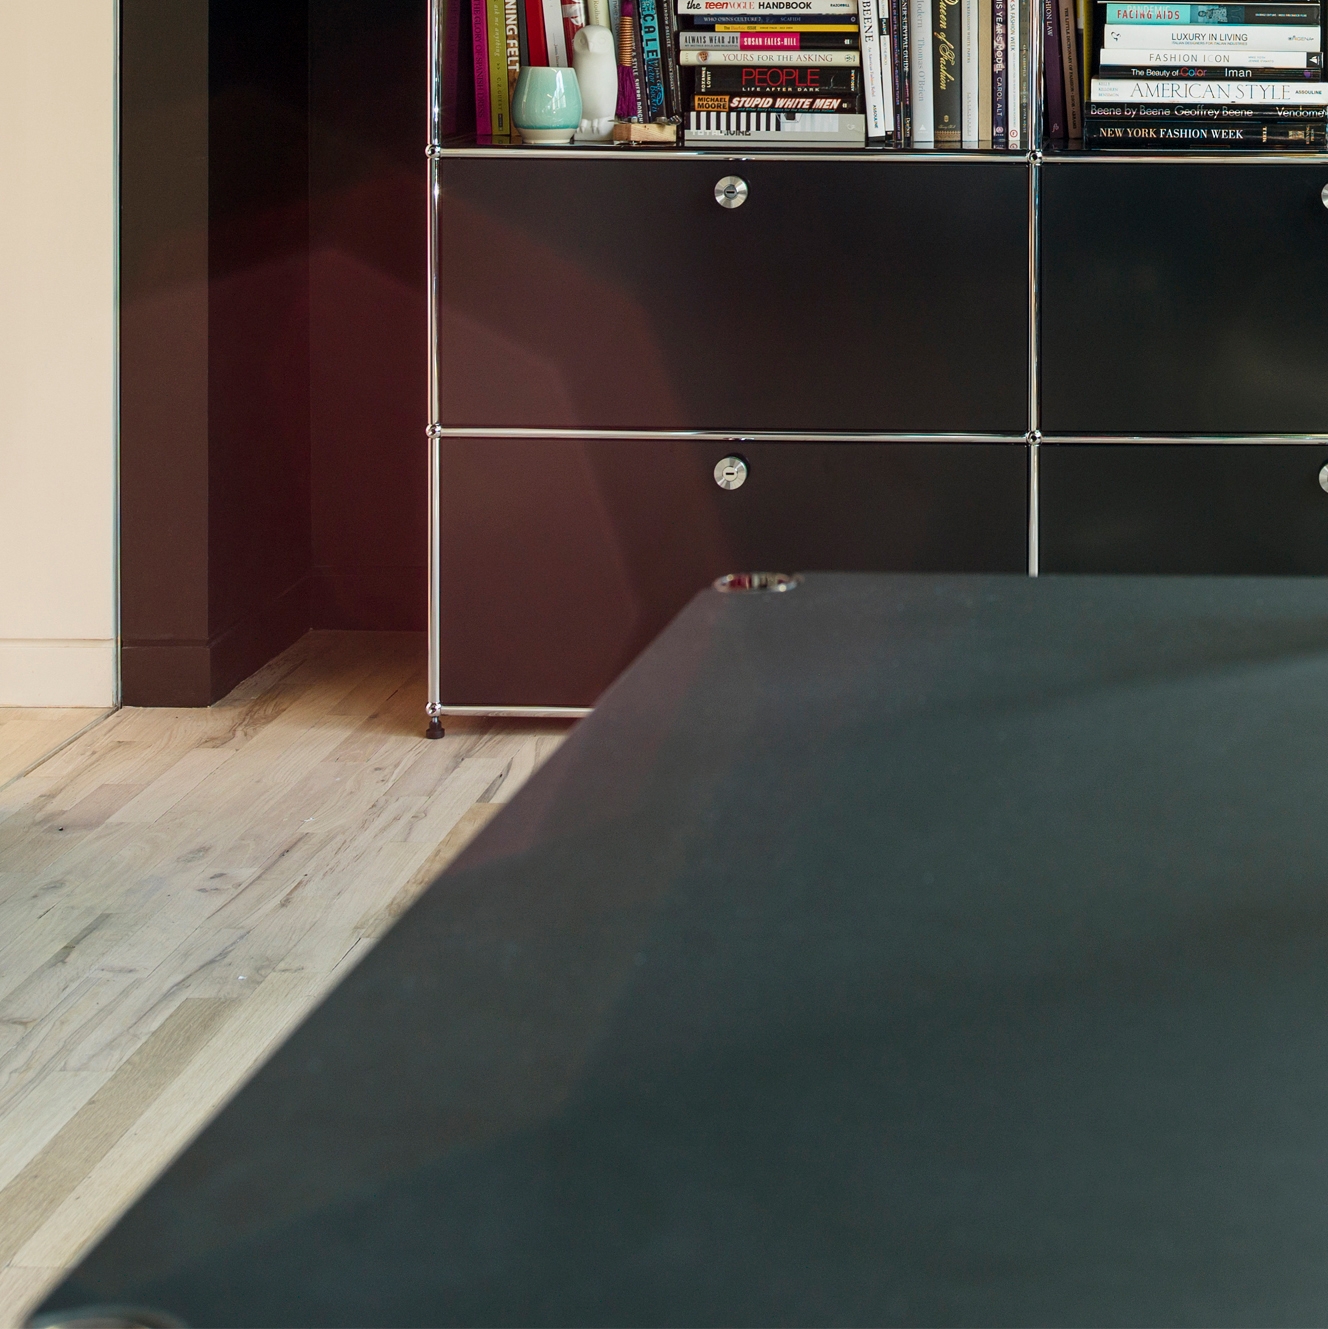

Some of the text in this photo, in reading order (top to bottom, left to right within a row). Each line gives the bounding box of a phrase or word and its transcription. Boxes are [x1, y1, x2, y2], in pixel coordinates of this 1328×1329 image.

[686, 0, 702, 10] the
[758, 1, 812, 10] HANDBOOK
[1117, 10, 1180, 20] FACING AIDS
[862, 0, 874, 42] BEENE
[1171, 33, 1248, 42] LUXURY IN LIVING
[505, 31, 520, 72] FELT
[722, 54, 833, 62] YOURS FOR THE ASKING
[741, 68, 820, 87] PEOPLE
[1130, 83, 1291, 100] AMERICAN STYLE
[730, 97, 841, 109] STUPID WHITE MEN
[1100, 128, 1244, 139] NEW YORK FASHION WEEK
